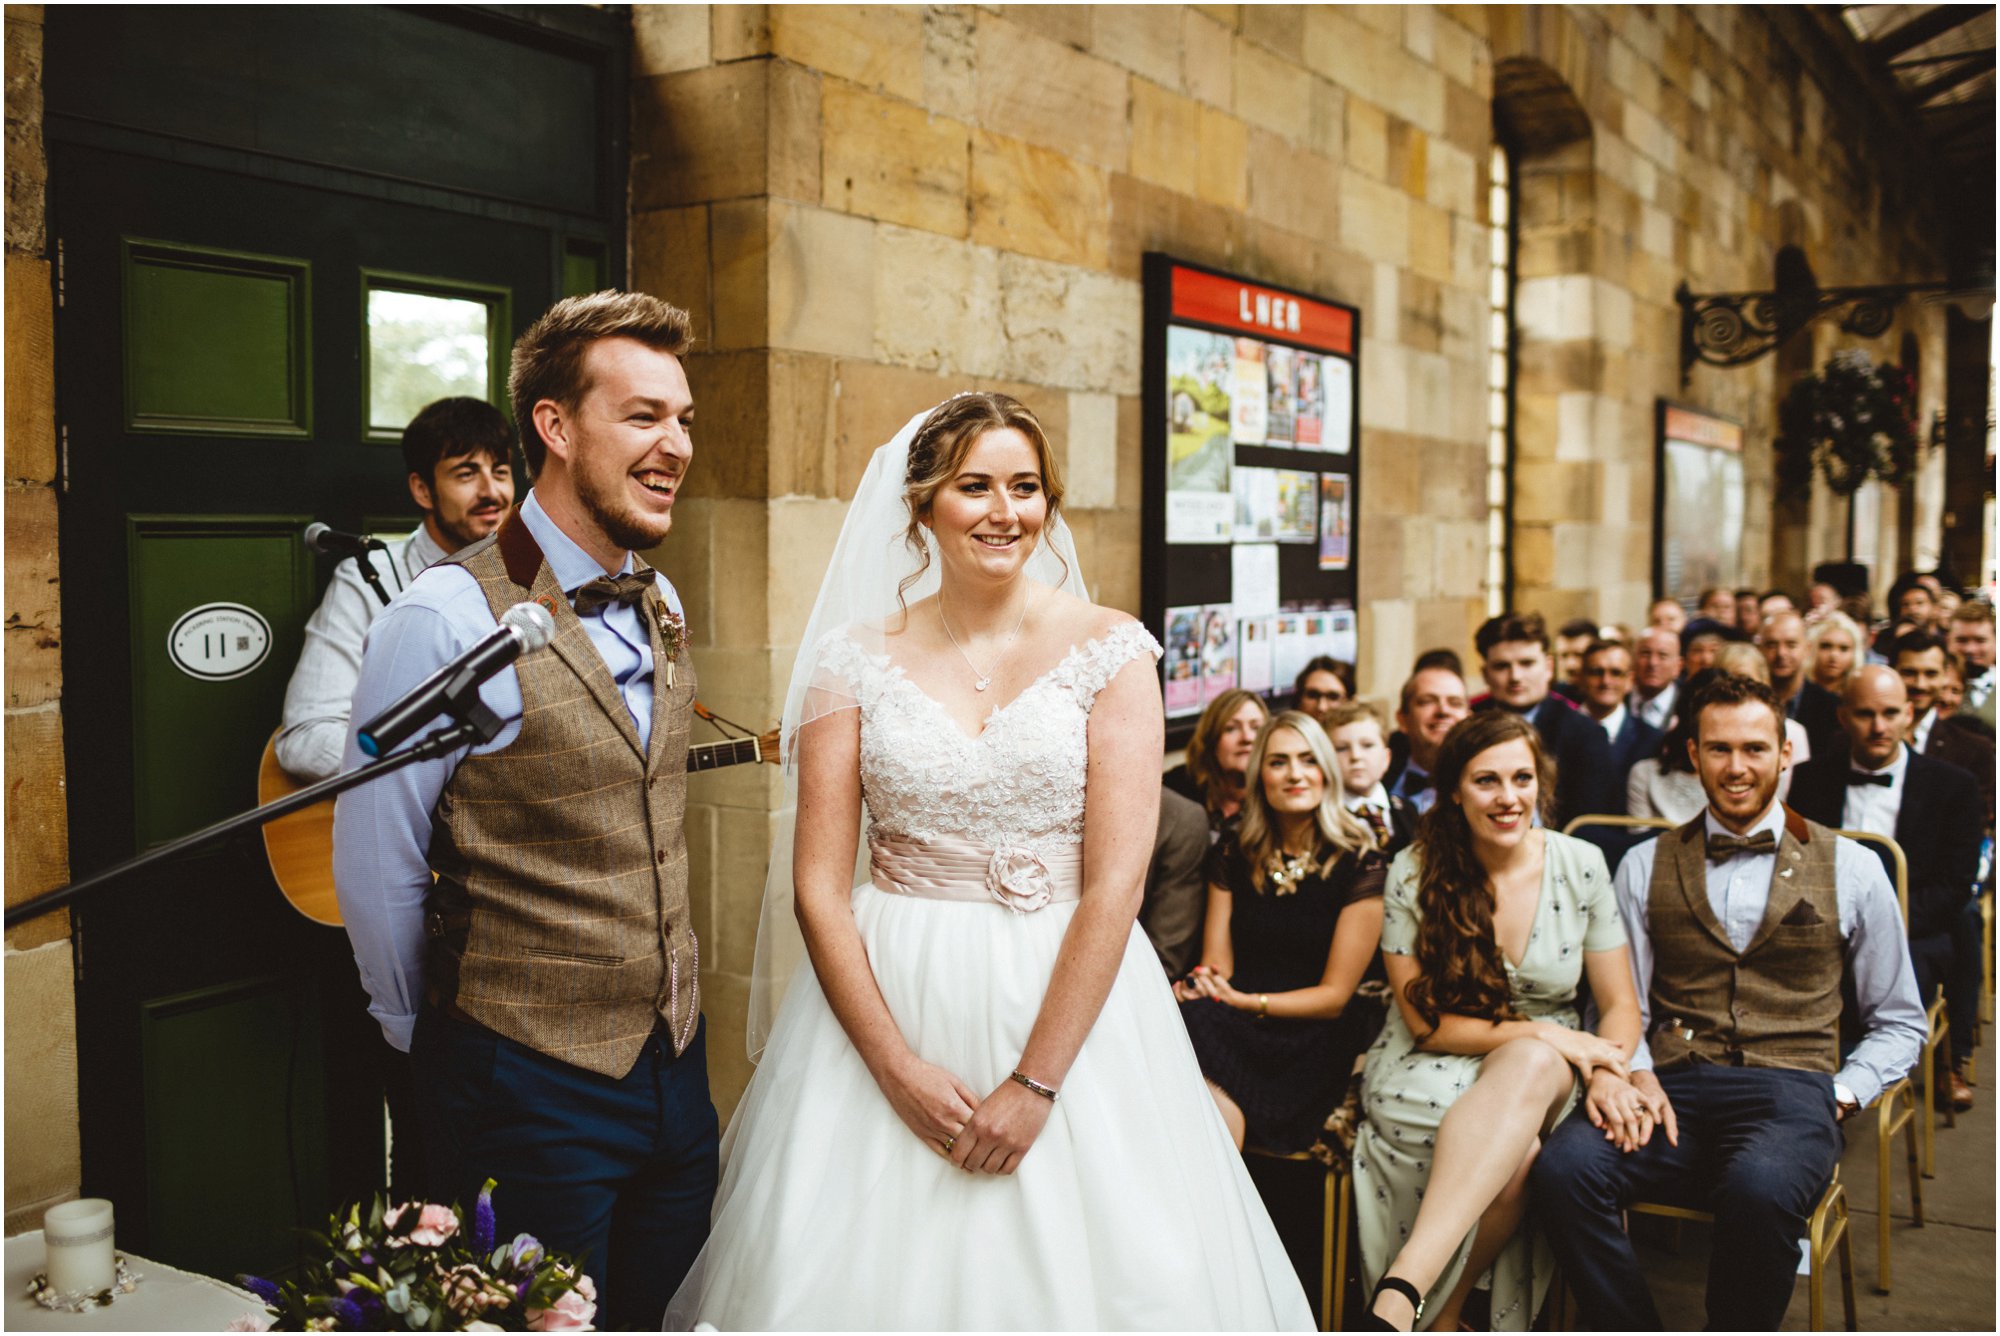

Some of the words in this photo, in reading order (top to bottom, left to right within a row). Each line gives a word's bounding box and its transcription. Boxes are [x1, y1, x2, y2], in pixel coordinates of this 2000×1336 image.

[1239, 288, 1300, 332] LNER
[184, 618, 214, 637] PICKERING
[216, 615, 241, 624] STATION
[205, 633, 225, 659] 11
